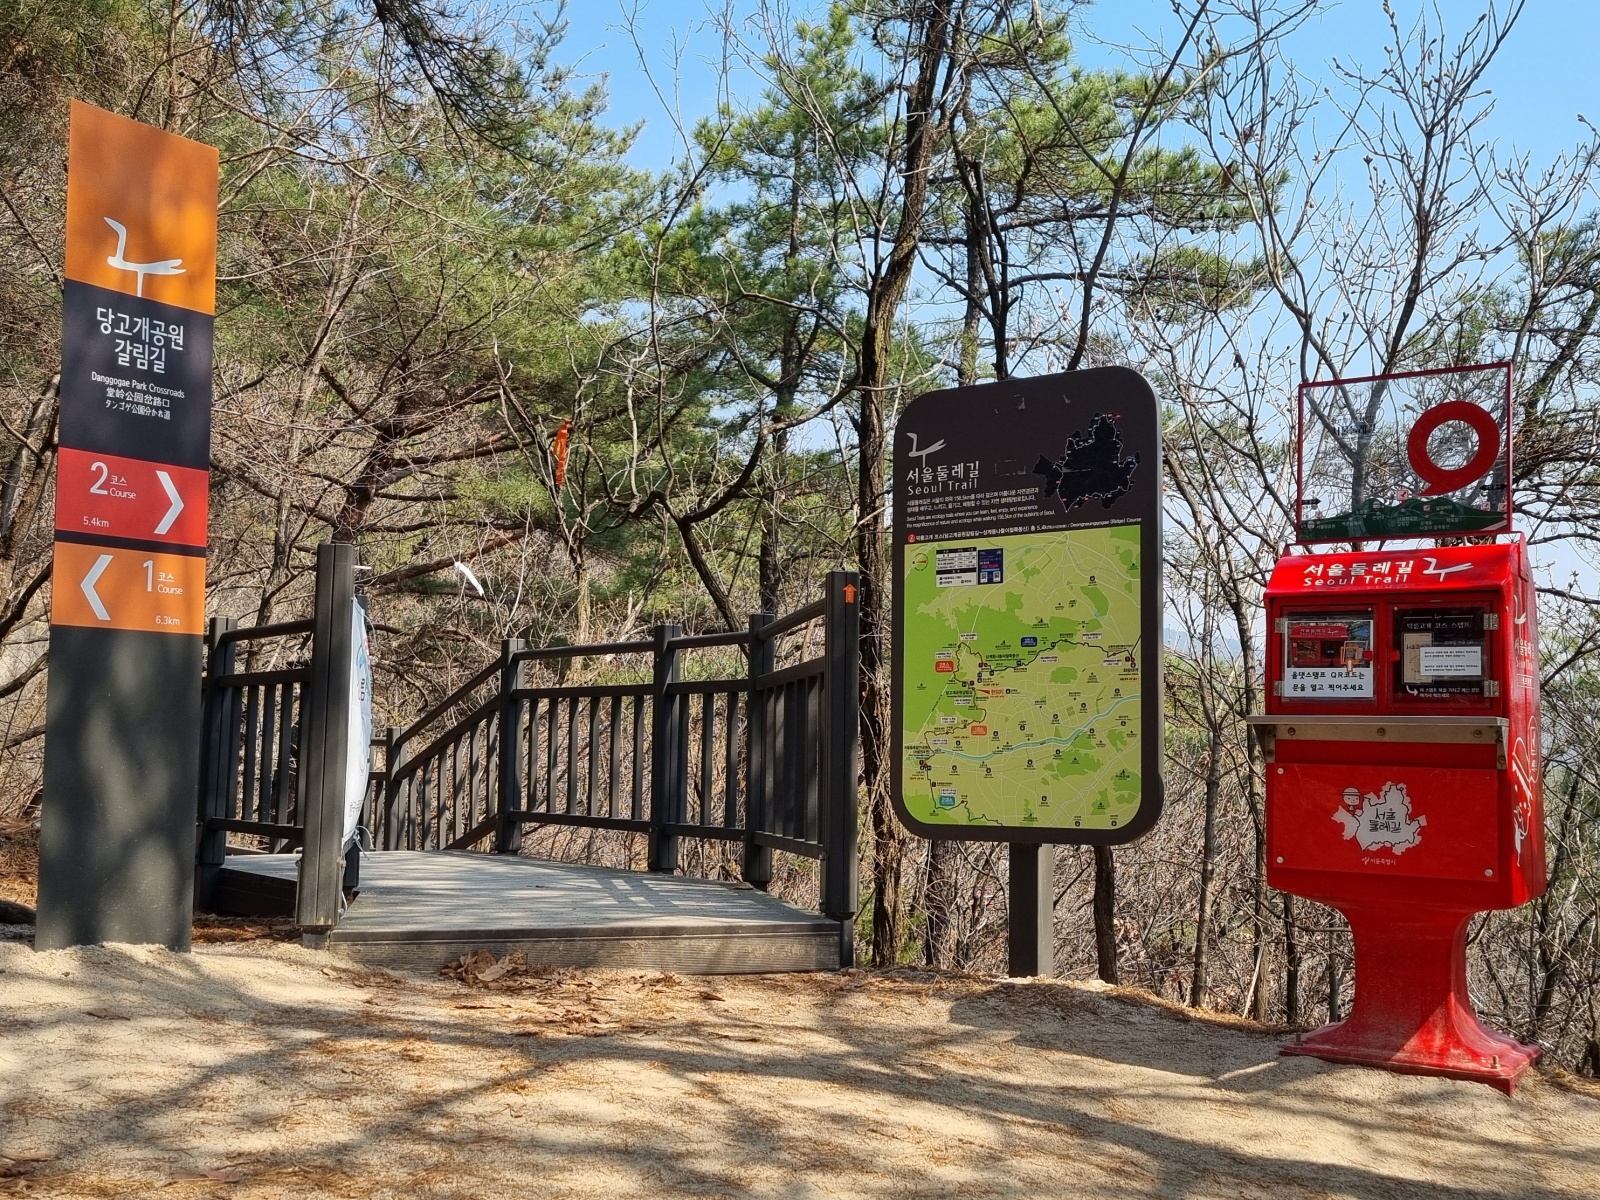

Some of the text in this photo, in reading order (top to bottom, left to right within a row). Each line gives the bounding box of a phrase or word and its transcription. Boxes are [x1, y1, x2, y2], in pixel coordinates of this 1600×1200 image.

[96, 307, 184, 351] 당고개공원
[114, 339, 166, 374] 갈림길
[91, 371, 185, 398] Danggogae Park Crossroads
[106, 387, 170, 408] 堂岭公园岔路口
[105, 400, 171, 420] タンゴゲ公園分かれ道
[89, 461, 127, 495] 2 코스
[906, 461, 980, 484] 서울둘레길
[109, 487, 136, 500] Course
[907, 478, 977, 496] Seoul Trail
[83, 516, 109, 528] 5.4km
[143, 560, 175, 592] 1 코스
[1303, 560, 1414, 577] 서울둘레길
[1303, 574, 1408, 587] Seoul Trail
[157, 584, 183, 595] Course
[155, 615, 180, 626] 6.3km
[1291, 671, 1365, 680] 올댓스탬프 QR코드는
[1292, 683, 1364, 692] 문을 열고 찍어주세요
[1375, 808, 1396, 820] 서울
[1369, 820, 1402, 833] 둘레길
[1370, 857, 1396, 865] 서울특별시
